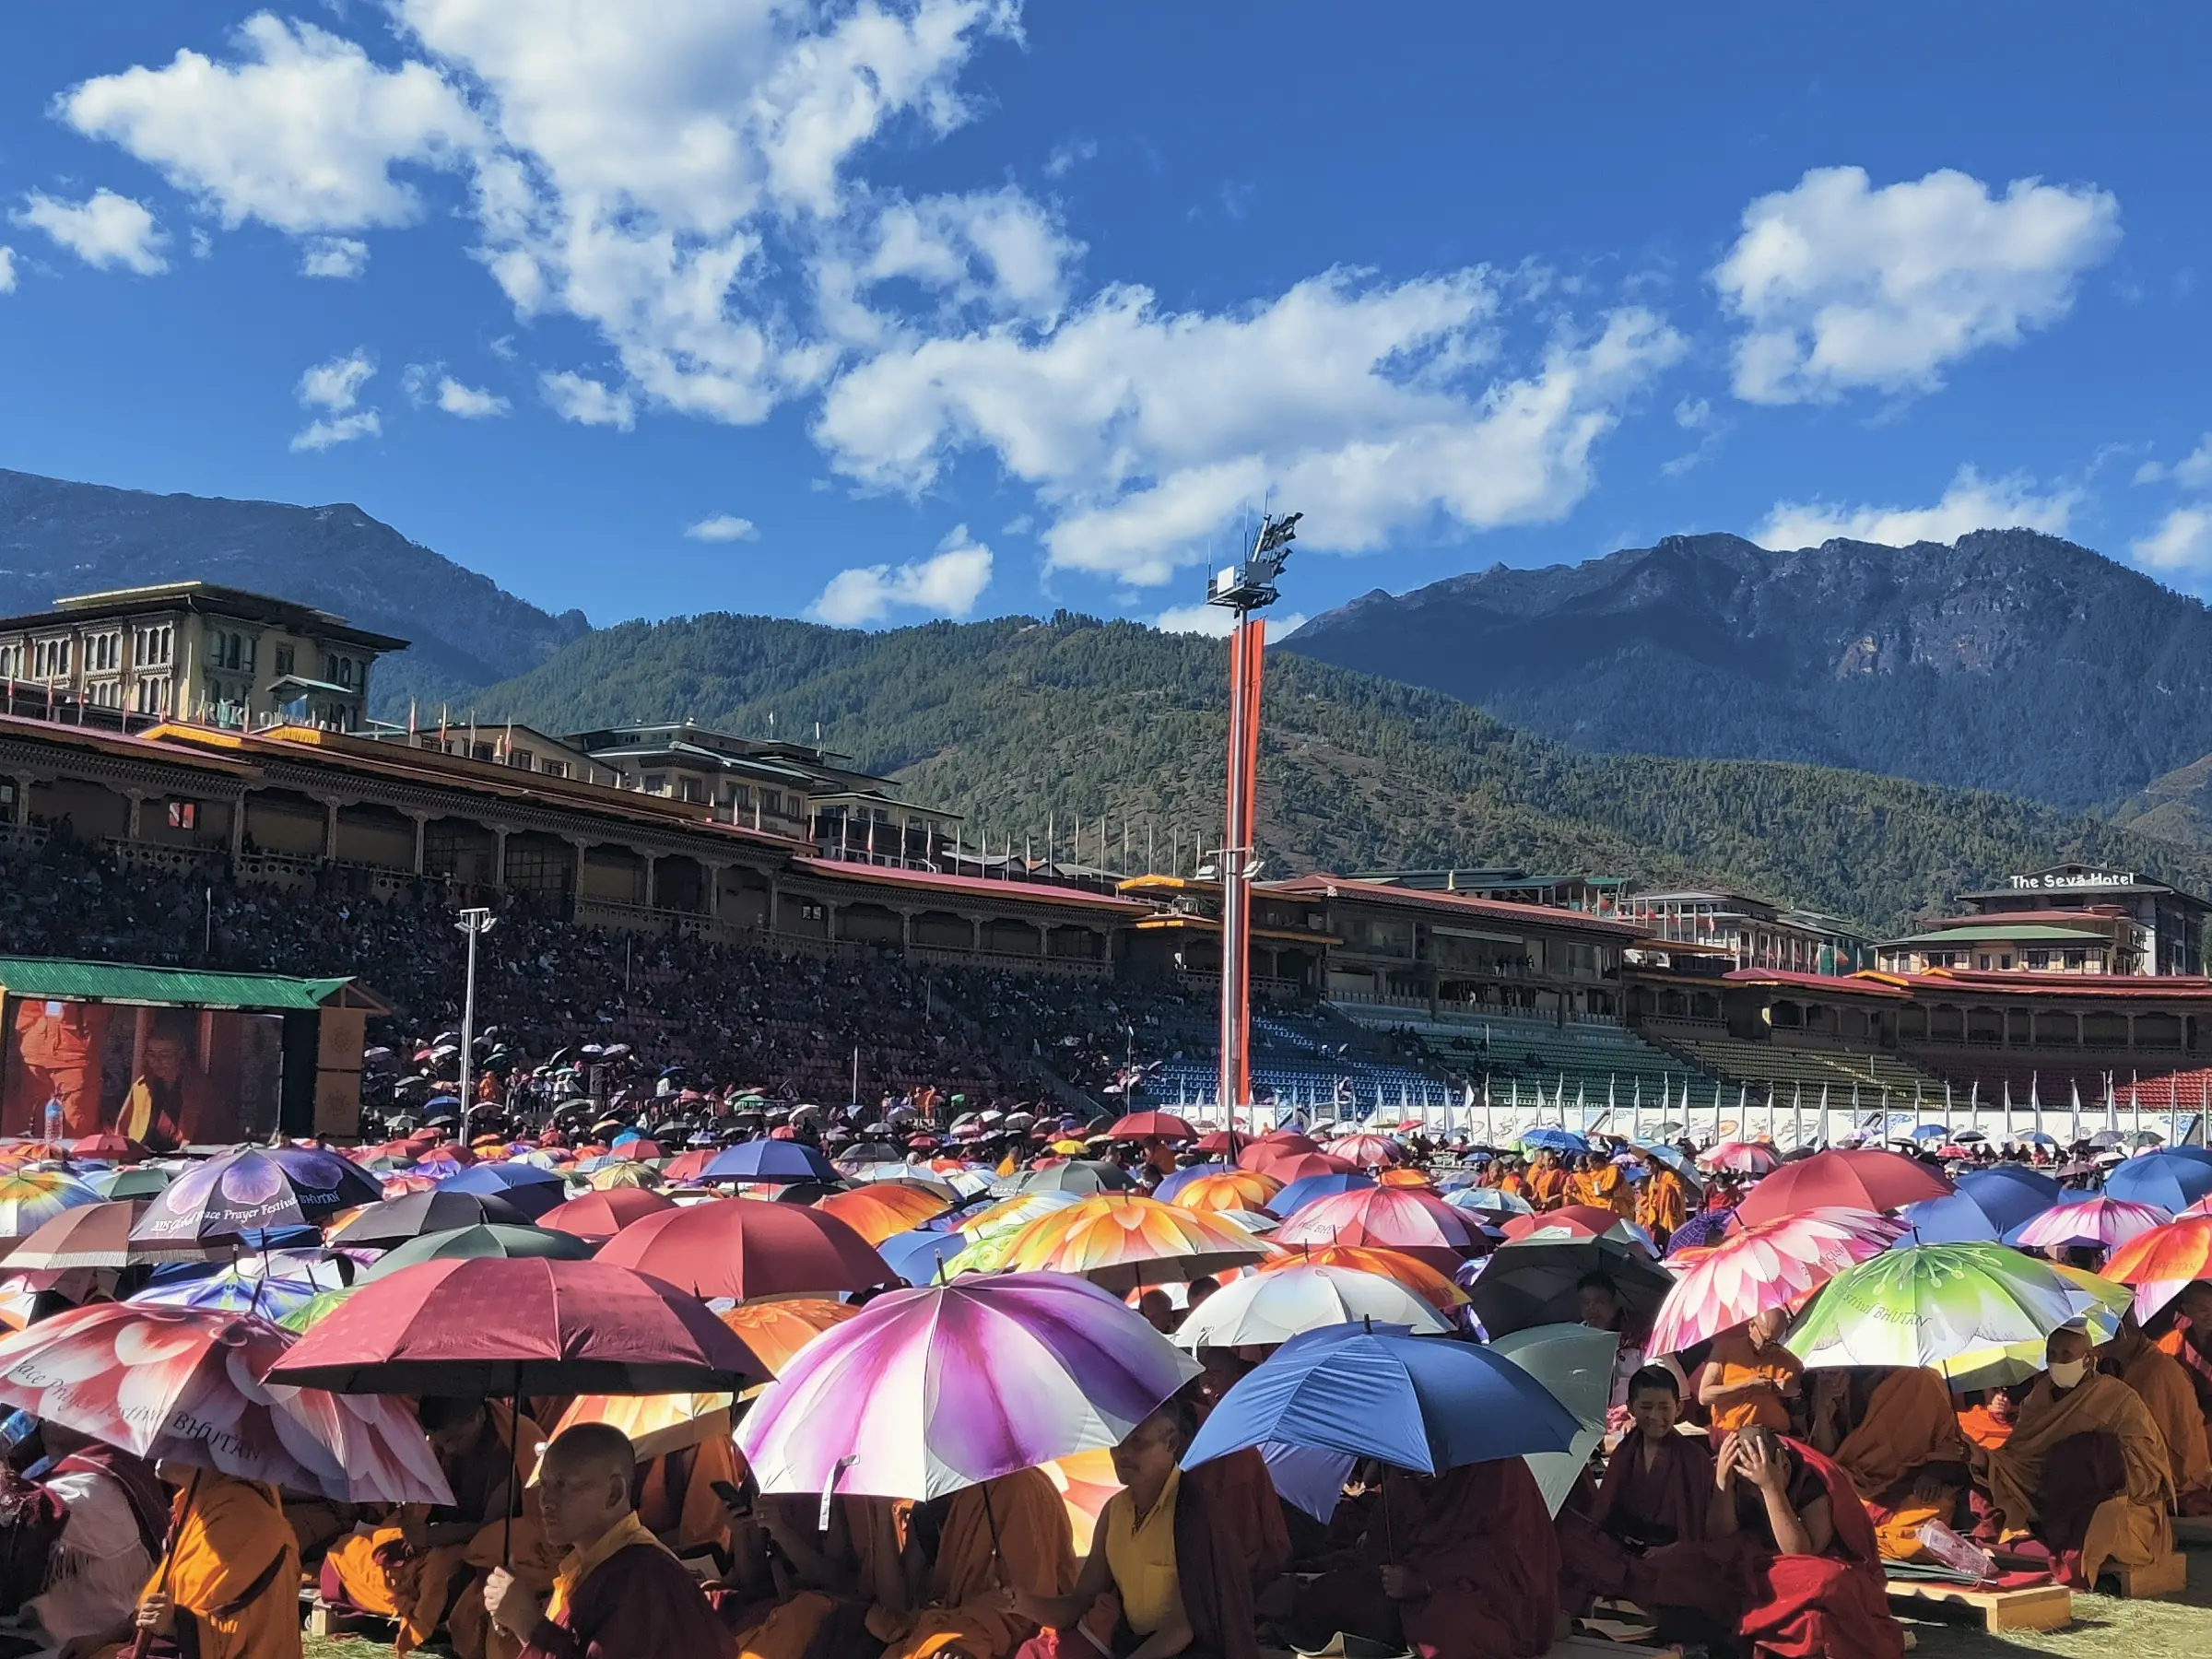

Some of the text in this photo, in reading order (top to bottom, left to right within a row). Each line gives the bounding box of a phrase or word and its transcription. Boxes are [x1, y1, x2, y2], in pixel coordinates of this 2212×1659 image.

[2010, 876, 2039, 888] The
[2090, 873, 2134, 886] Hotel
[223, 1207, 259, 1224] Prayer
[1873, 1305, 1933, 1327] BHUTAN
[172, 1411, 261, 1462] BHUTAN
